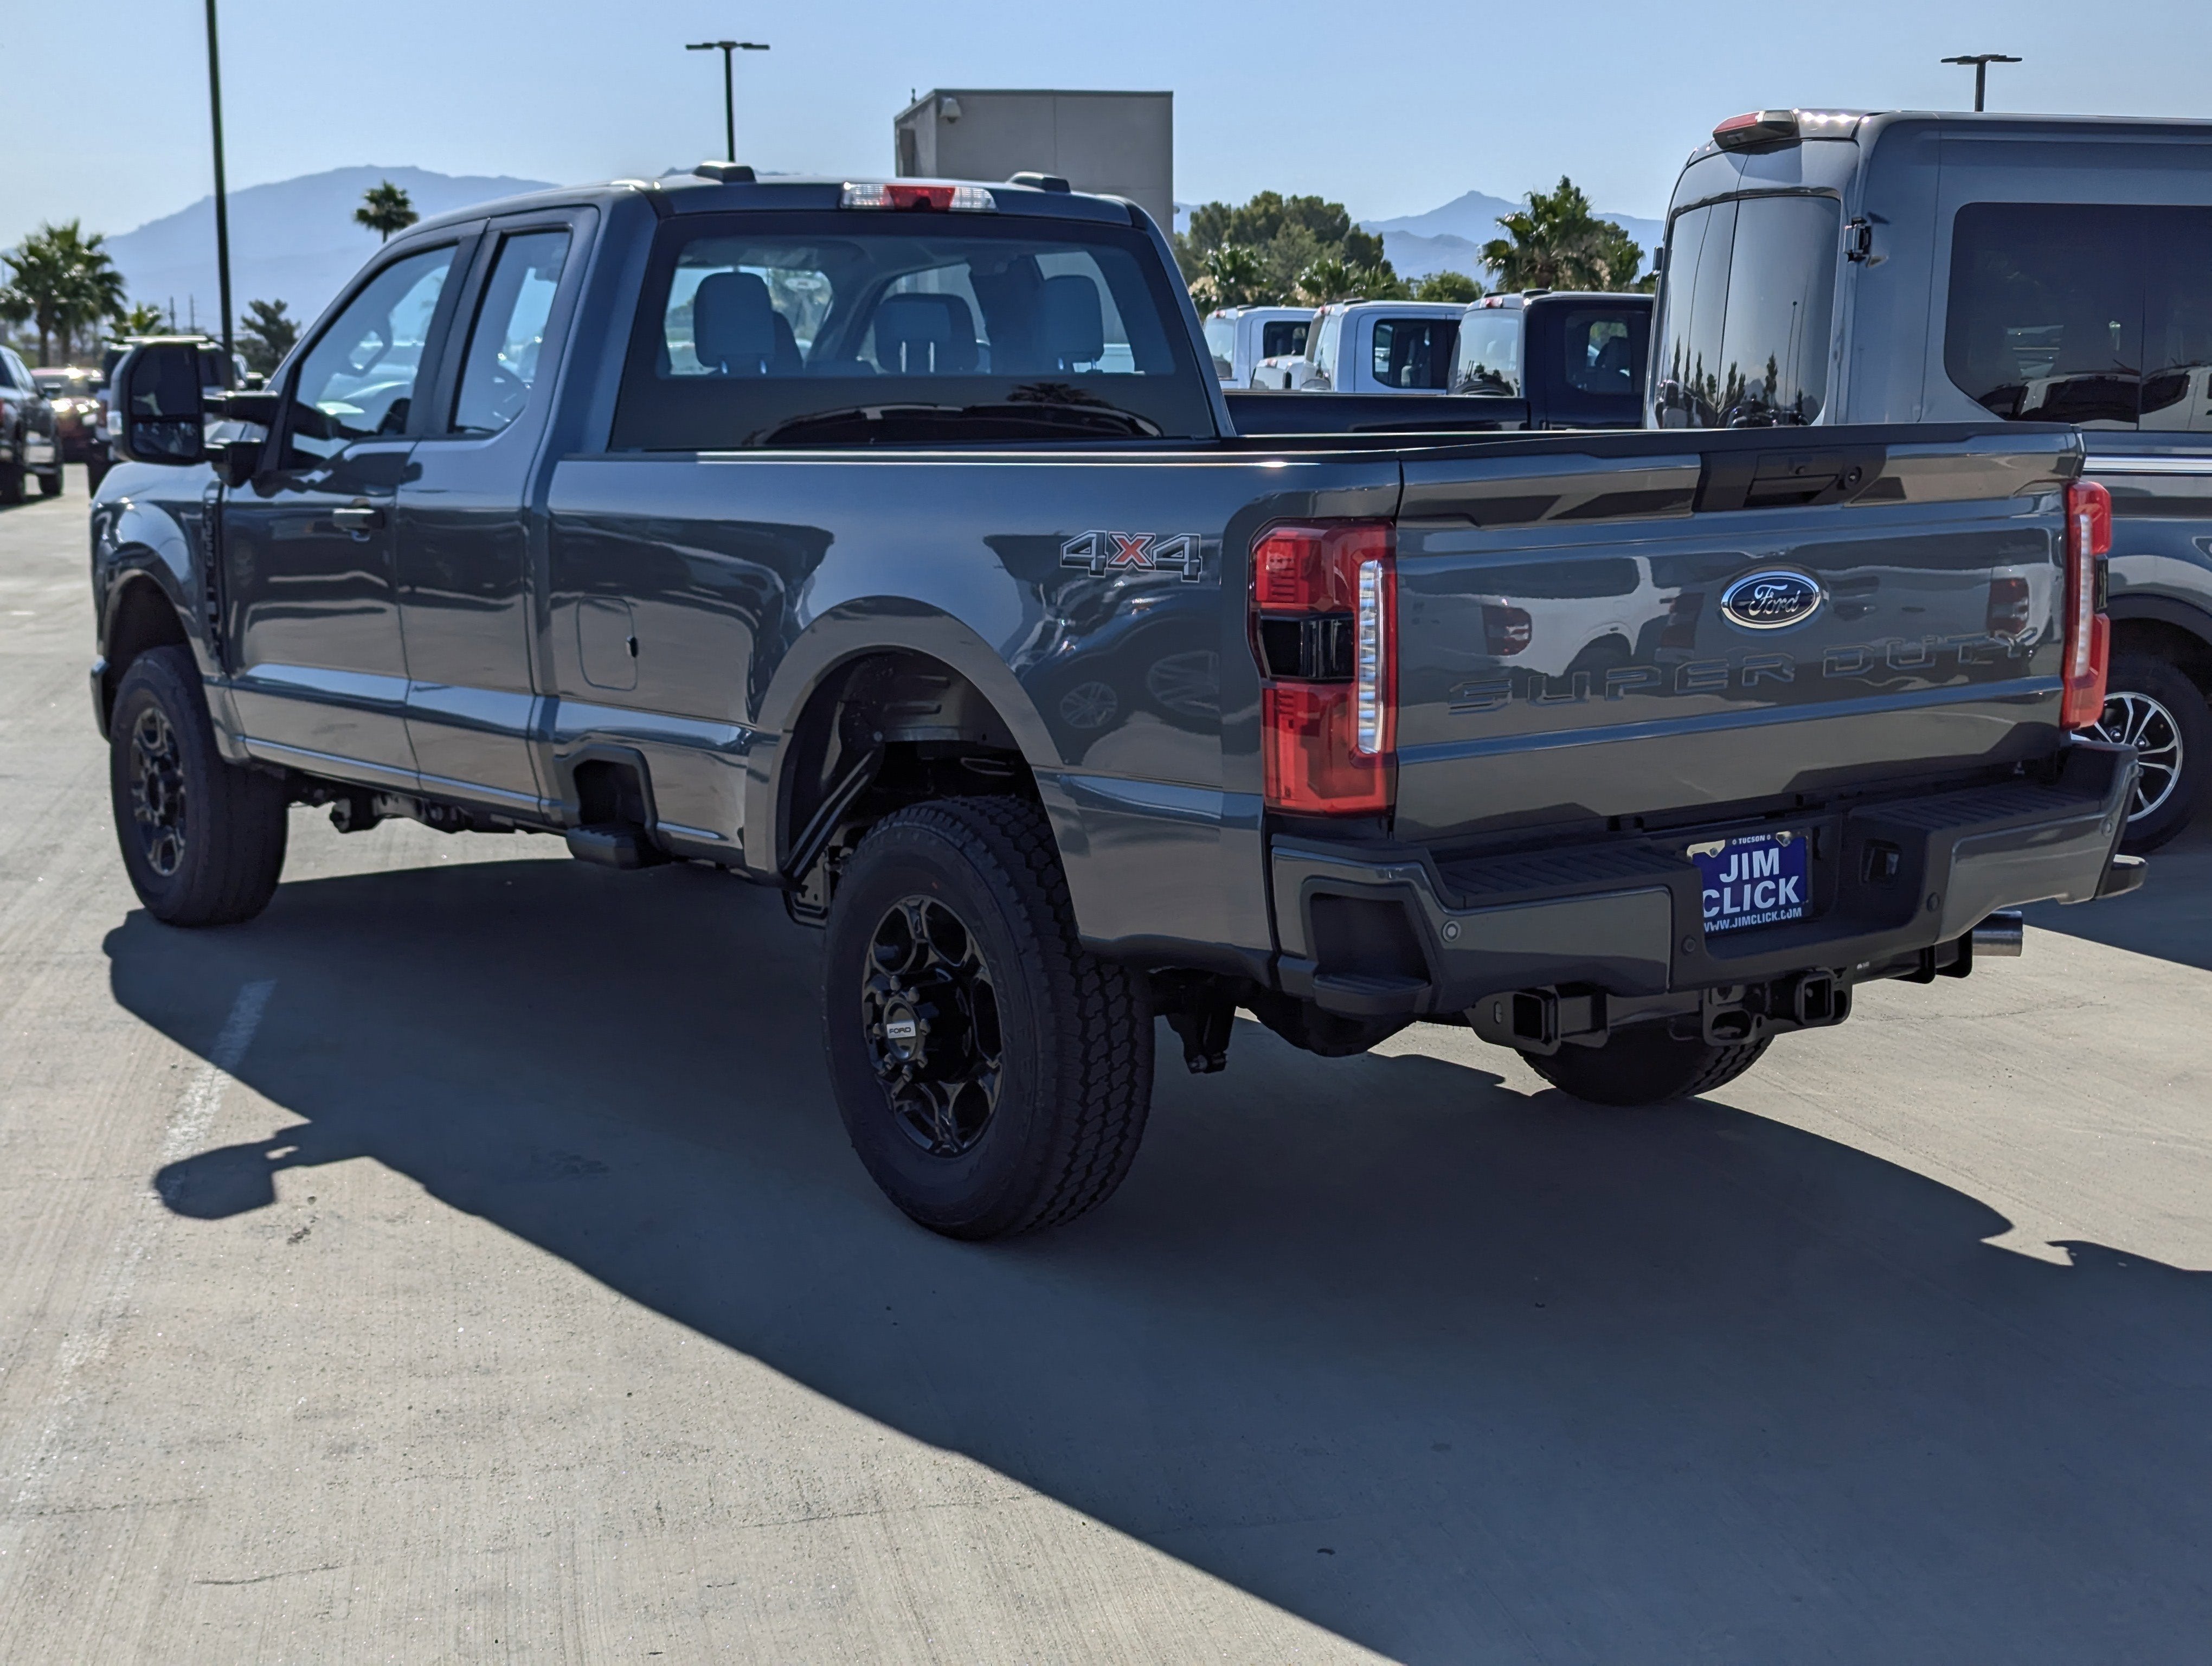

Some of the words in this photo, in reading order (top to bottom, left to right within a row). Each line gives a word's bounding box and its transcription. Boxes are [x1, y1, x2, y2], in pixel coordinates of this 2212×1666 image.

[1748, 584, 1801, 616] Ford
[1449, 652, 1796, 715] SUPER
[1823, 627, 2039, 678] DUTY
[1738, 835, 1765, 844] TUCSON
[1719, 847, 1780, 883] JIM
[1702, 875, 1800, 918] CLICK
